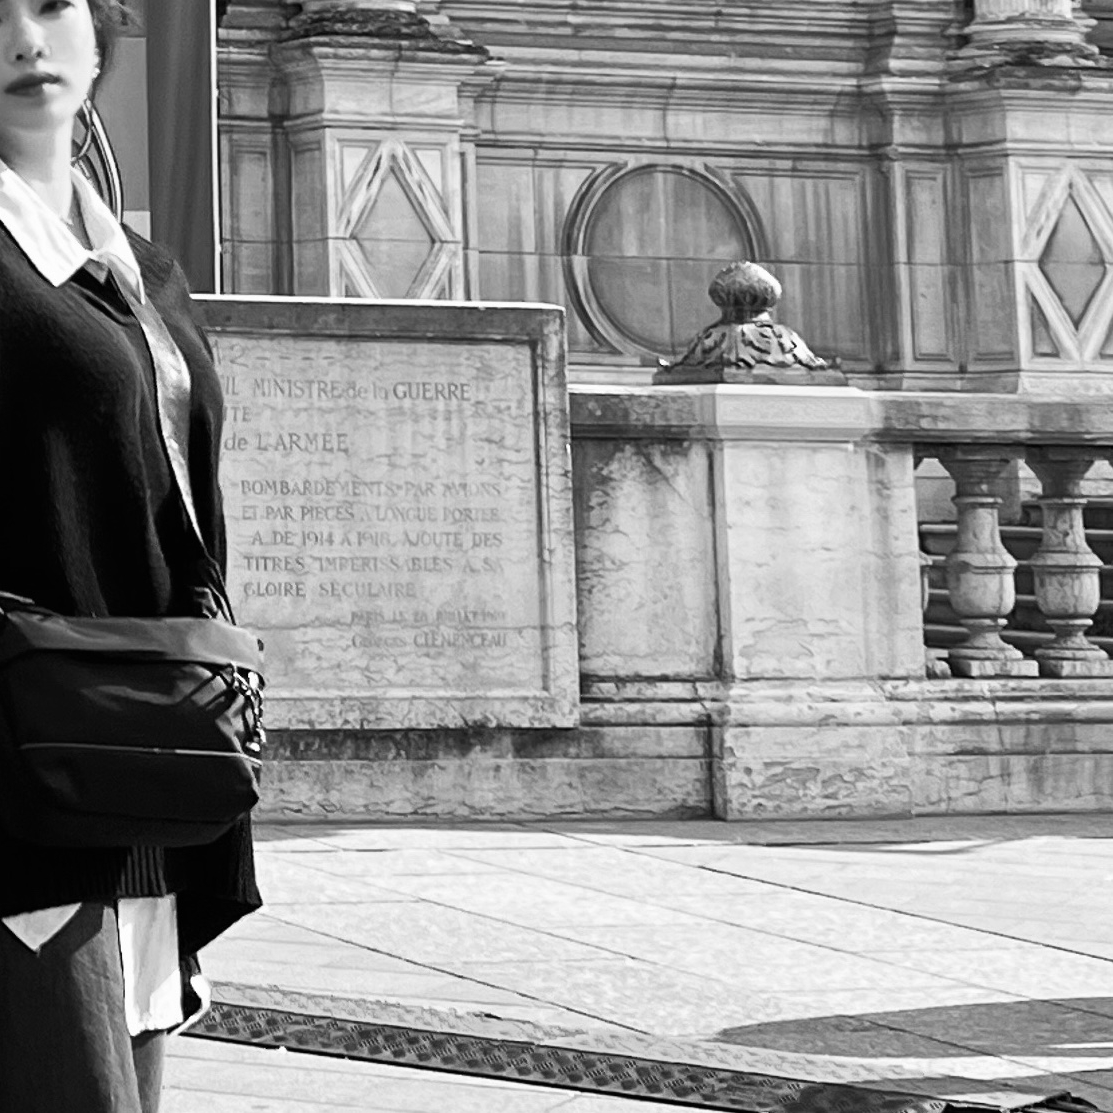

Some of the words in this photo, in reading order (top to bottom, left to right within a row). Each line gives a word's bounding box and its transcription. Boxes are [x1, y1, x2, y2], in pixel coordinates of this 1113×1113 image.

[253, 377, 343, 399] MINISTRE
[392, 381, 471, 401] GUERRE
[223, 432, 248, 452] de
[265, 505, 296, 522] PAR
[272, 530, 296, 546] DE
[471, 531, 503, 549] DES
[243, 555, 305, 572] TITRES
[243, 581, 307, 598] GLOIRE
